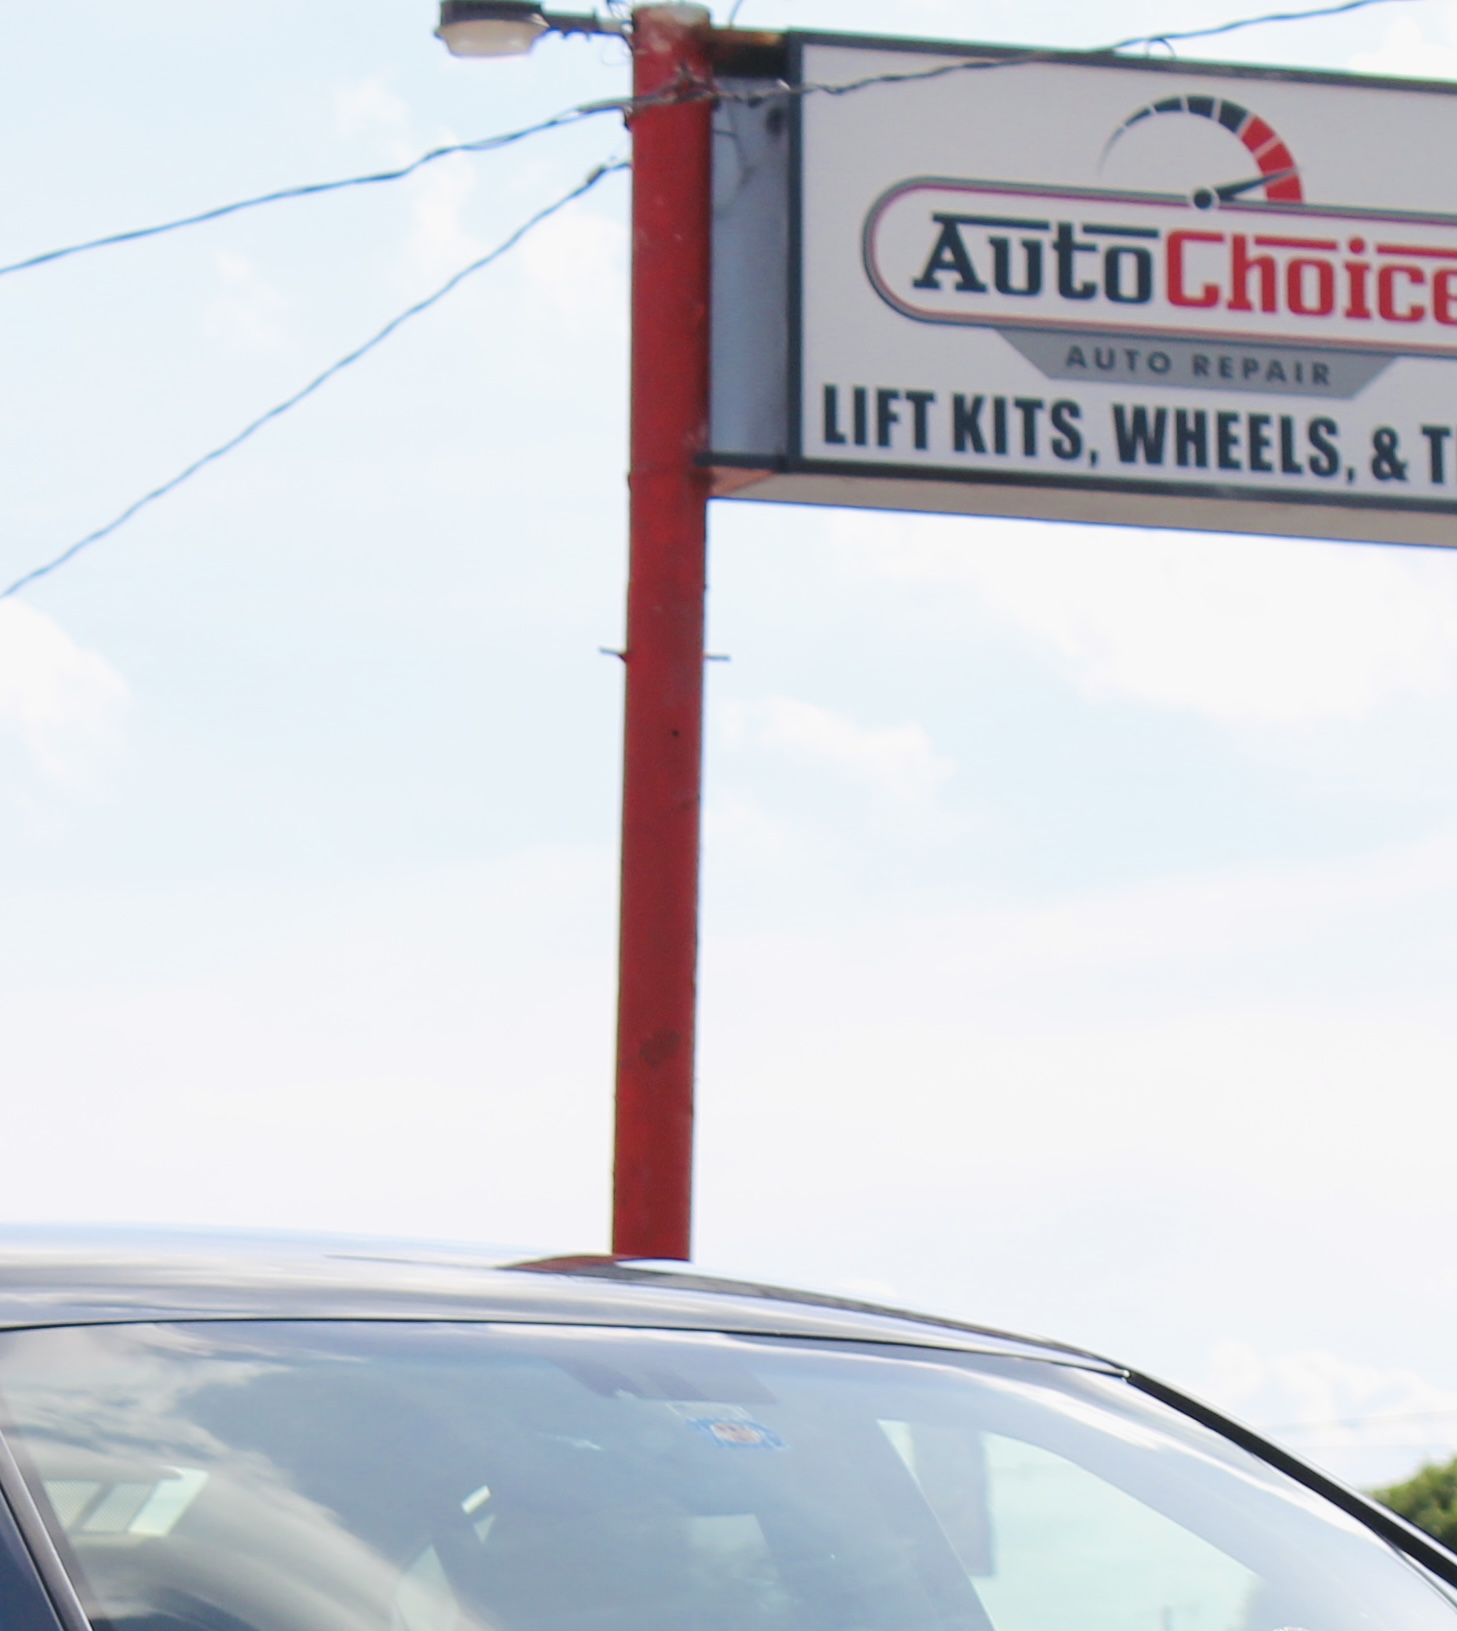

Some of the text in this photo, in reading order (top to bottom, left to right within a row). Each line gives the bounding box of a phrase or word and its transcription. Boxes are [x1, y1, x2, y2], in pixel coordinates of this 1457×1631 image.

[1064, 344, 1332, 387] AUTO REPAIR
[822, 384, 938, 452] LIFT
[952, 392, 1100, 468] KITS,
[1112, 403, 1356, 485] WHEELS,
[1370, 426, 1410, 484] &
